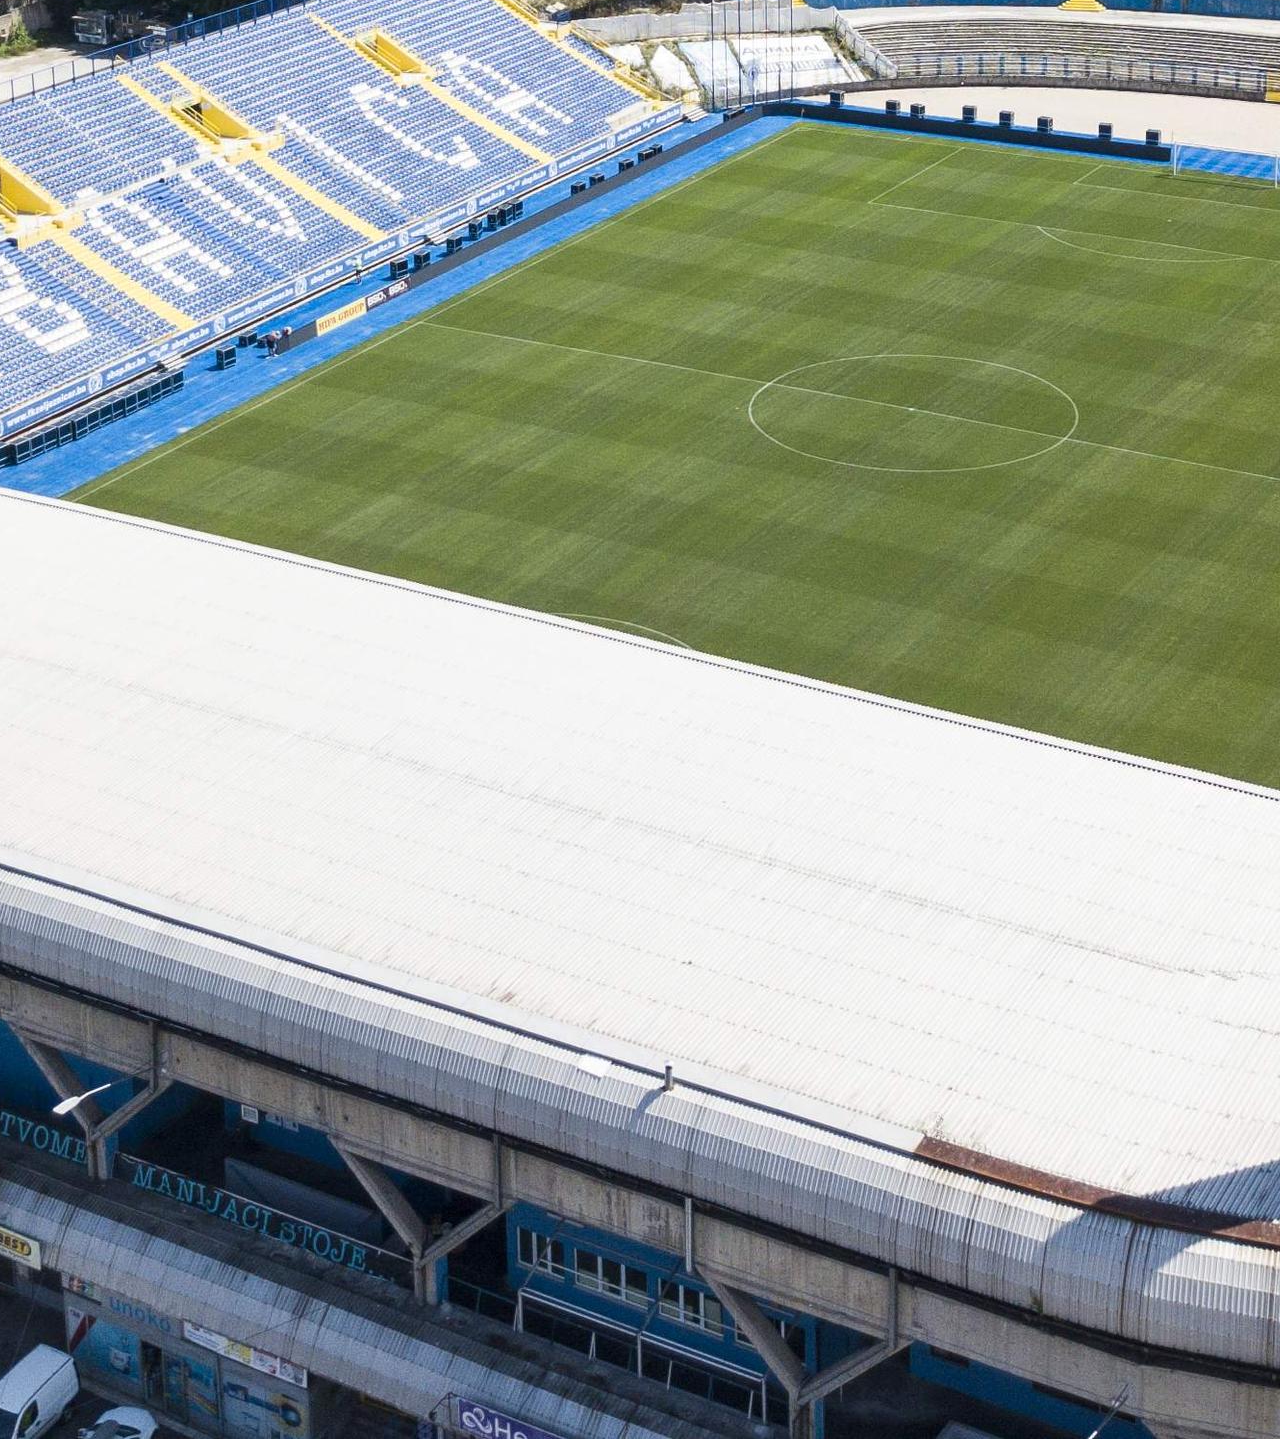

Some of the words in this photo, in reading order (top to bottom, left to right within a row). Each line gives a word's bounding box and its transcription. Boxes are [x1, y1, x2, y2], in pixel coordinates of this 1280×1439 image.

[338, 303, 365, 321] GROUP
[0, 1111, 88, 1165] TVOME
[132, 1164, 272, 1236] MANIJACI
